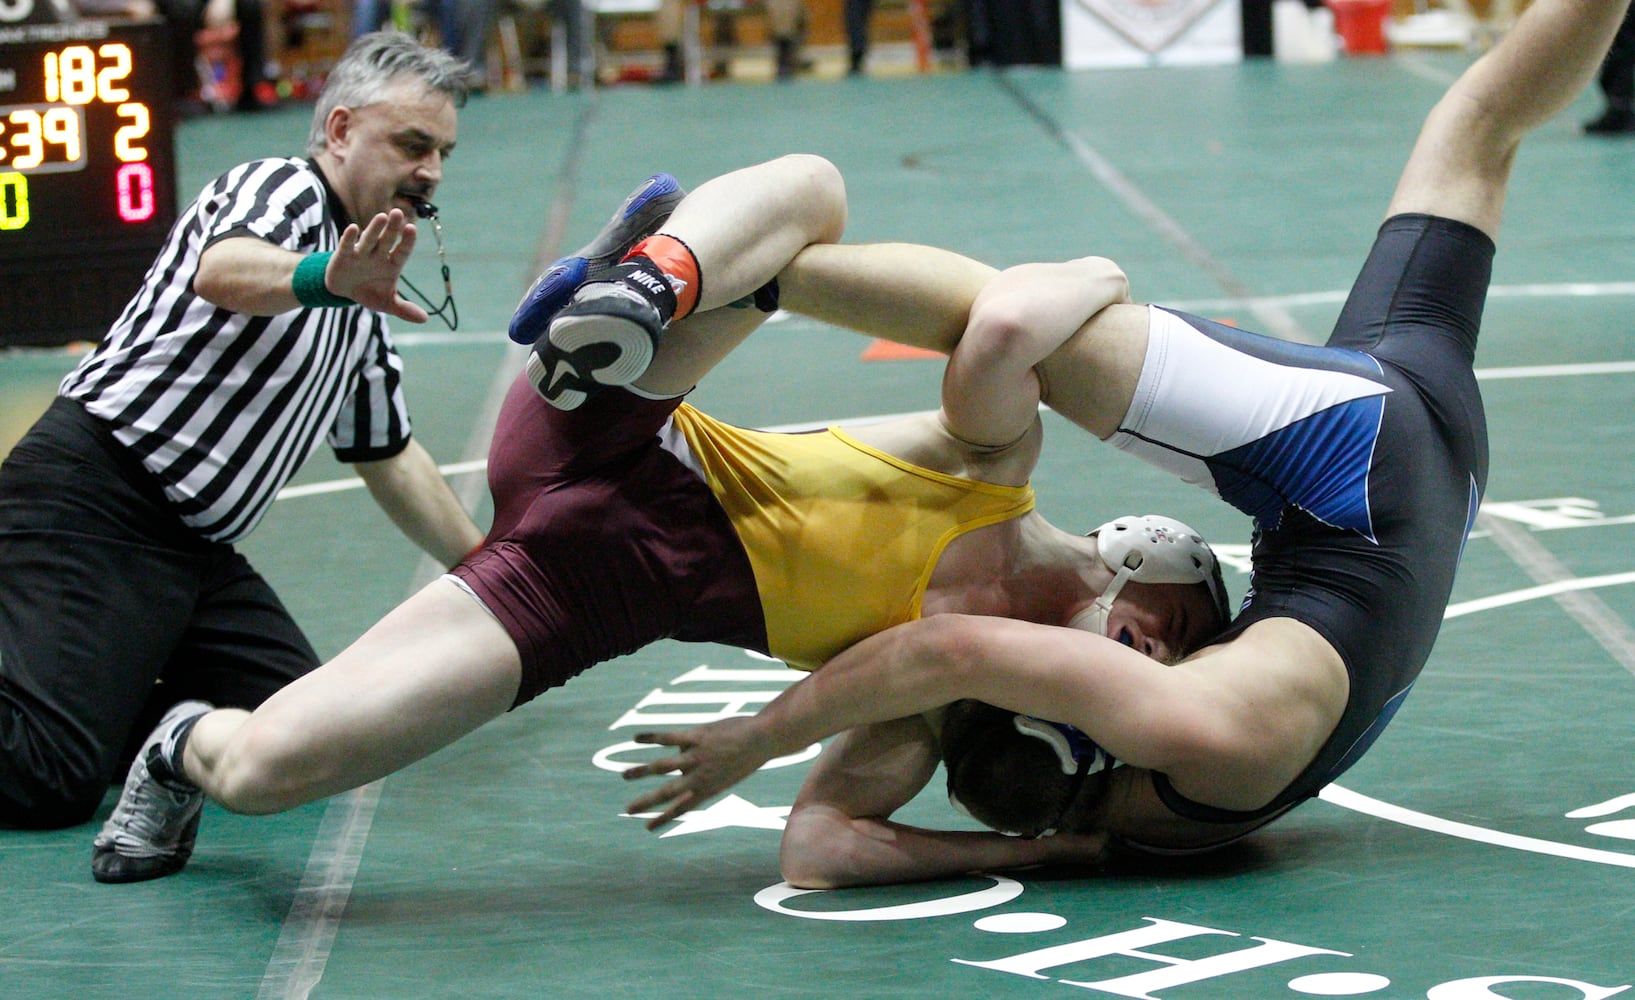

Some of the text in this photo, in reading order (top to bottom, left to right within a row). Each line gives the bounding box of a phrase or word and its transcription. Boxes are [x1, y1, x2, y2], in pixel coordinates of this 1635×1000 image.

[43, 43, 132, 105] 182
[115, 102, 150, 162] 2
[116, 162, 154, 222] 0
[627, 269, 666, 295] NIKE
